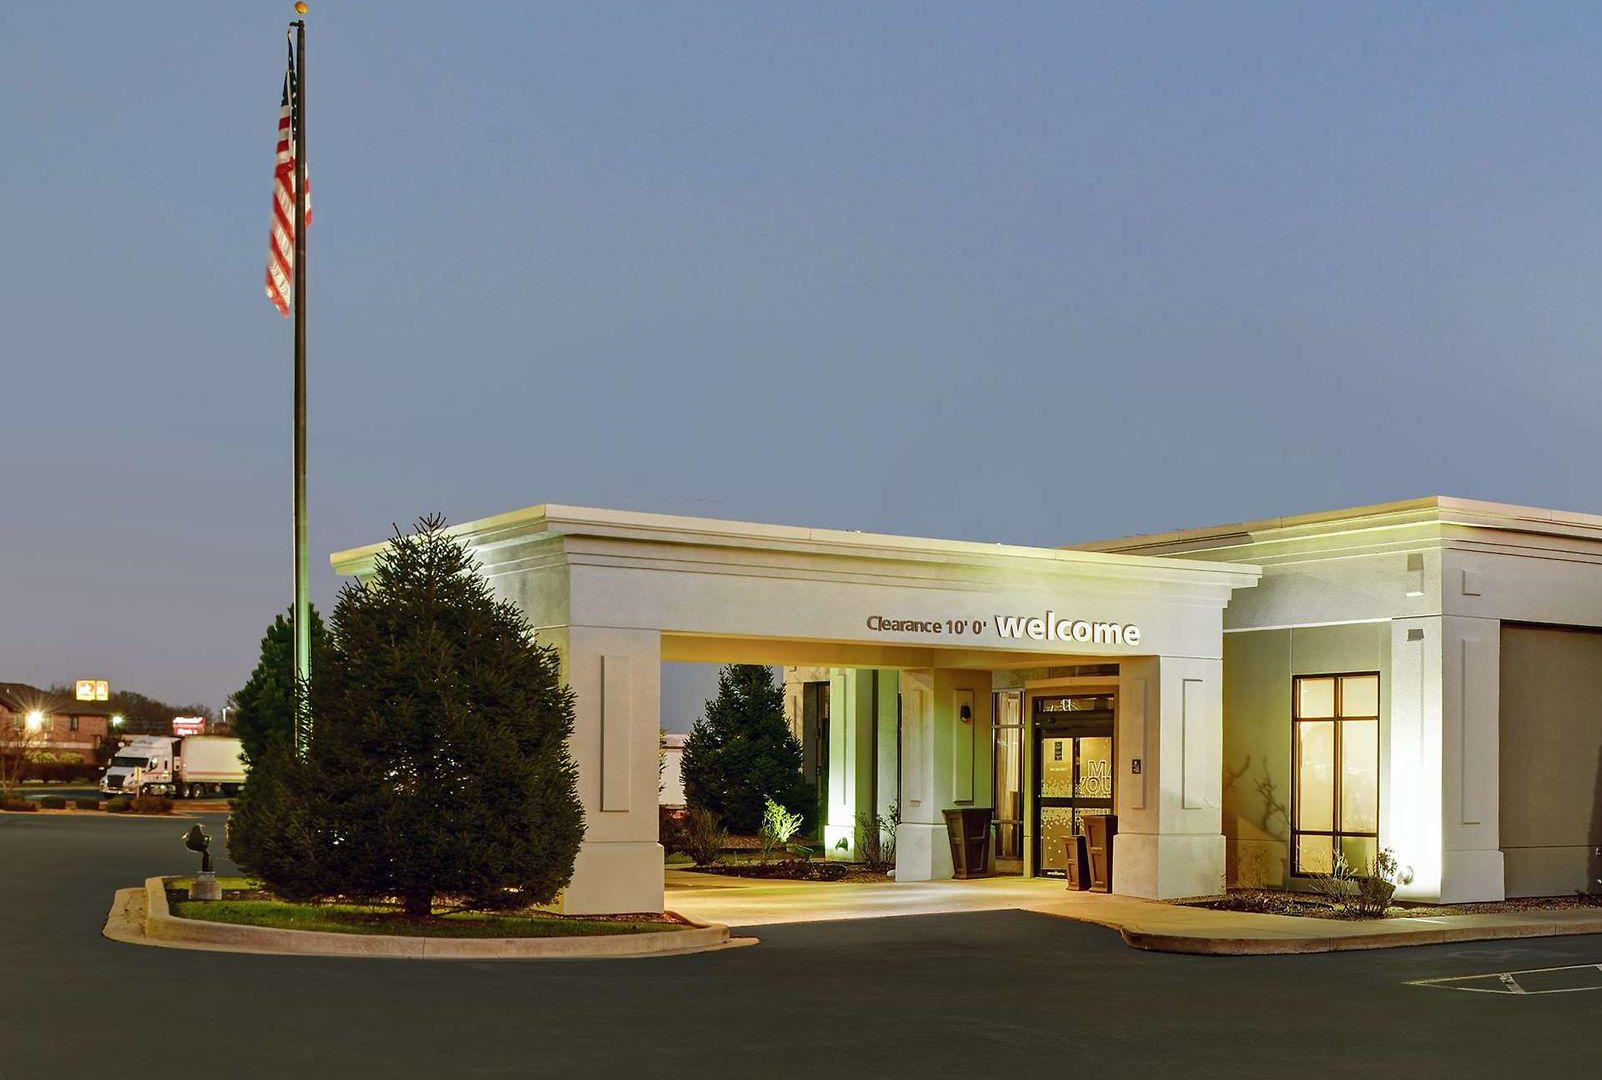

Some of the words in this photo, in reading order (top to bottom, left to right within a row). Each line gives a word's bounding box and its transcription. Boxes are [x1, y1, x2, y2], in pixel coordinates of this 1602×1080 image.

[866, 615, 942, 633] Clearance
[946, 619, 968, 635] 10'
[994, 610, 1140, 646] welcome
